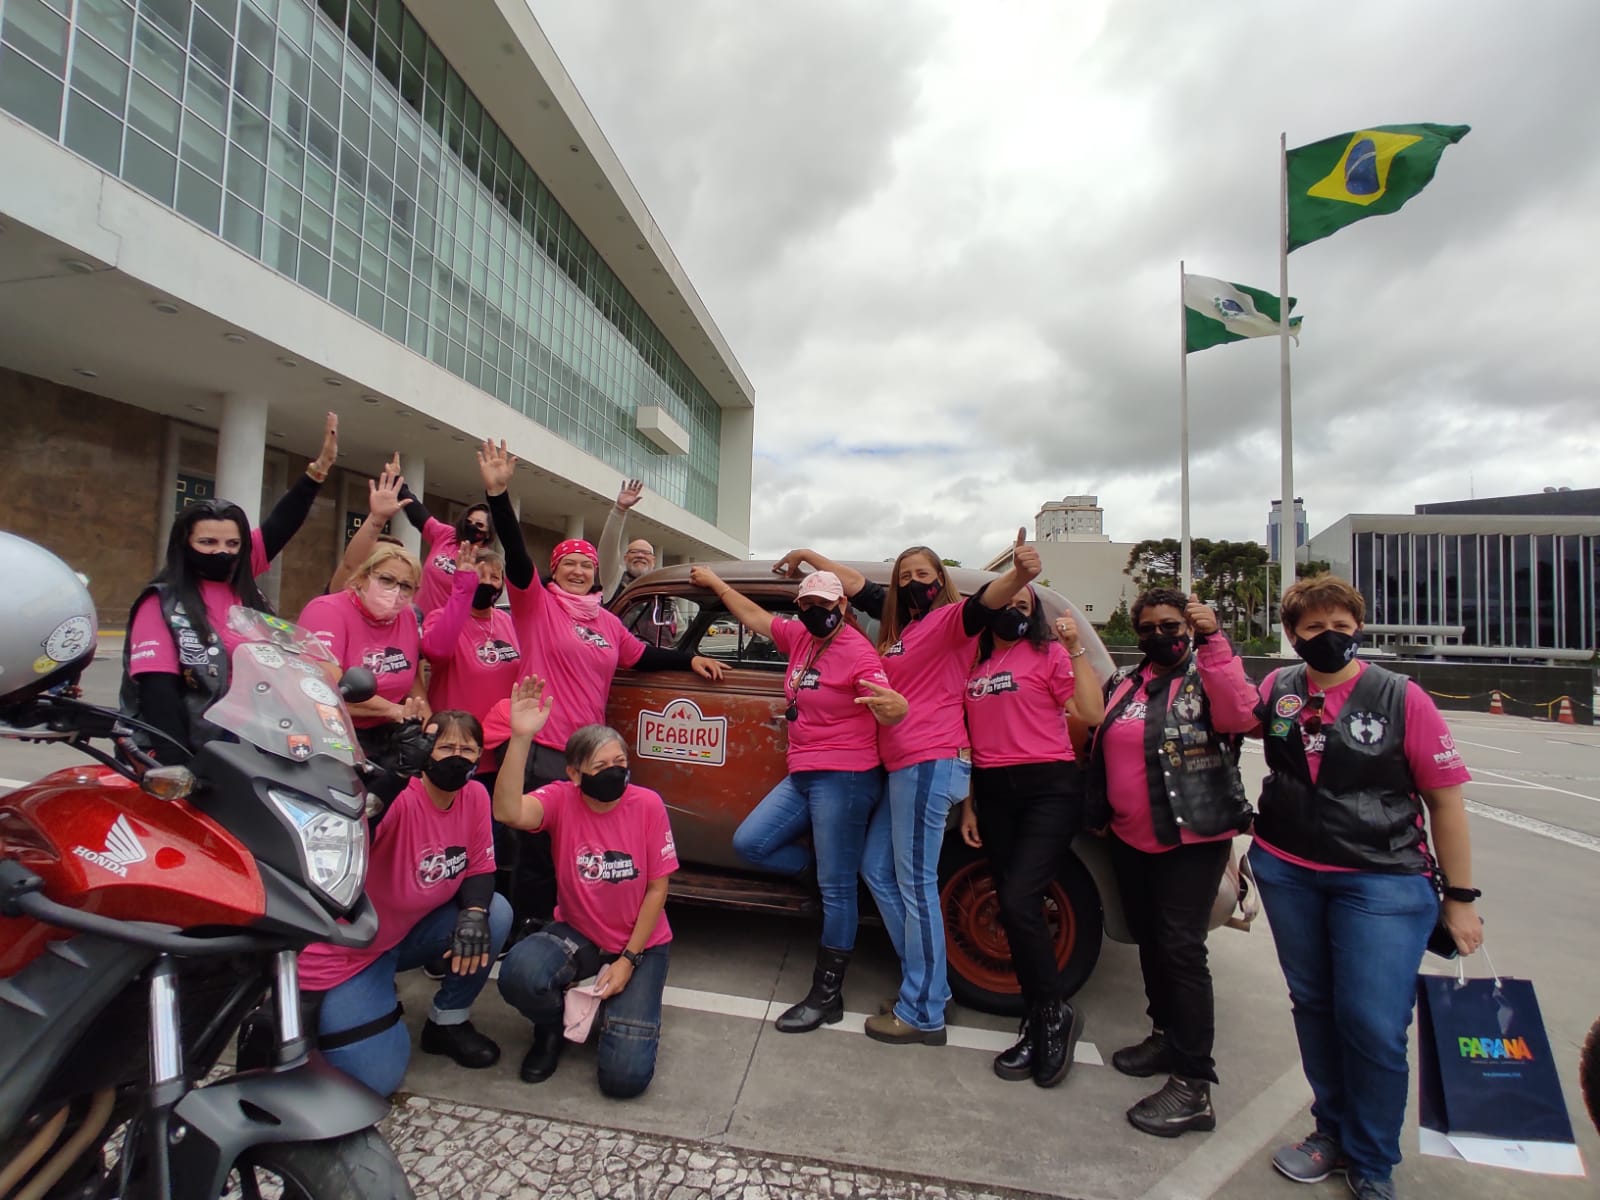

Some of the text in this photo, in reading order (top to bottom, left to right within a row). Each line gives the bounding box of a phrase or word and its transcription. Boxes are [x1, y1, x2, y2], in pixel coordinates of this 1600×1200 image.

[645, 720, 720, 748] PEABIRU
[71, 845, 129, 878] HONDA
[583, 855, 604, 880] 5
[602, 859, 633, 870] Fronteiras
[602, 867, 634, 879] do Paraná
